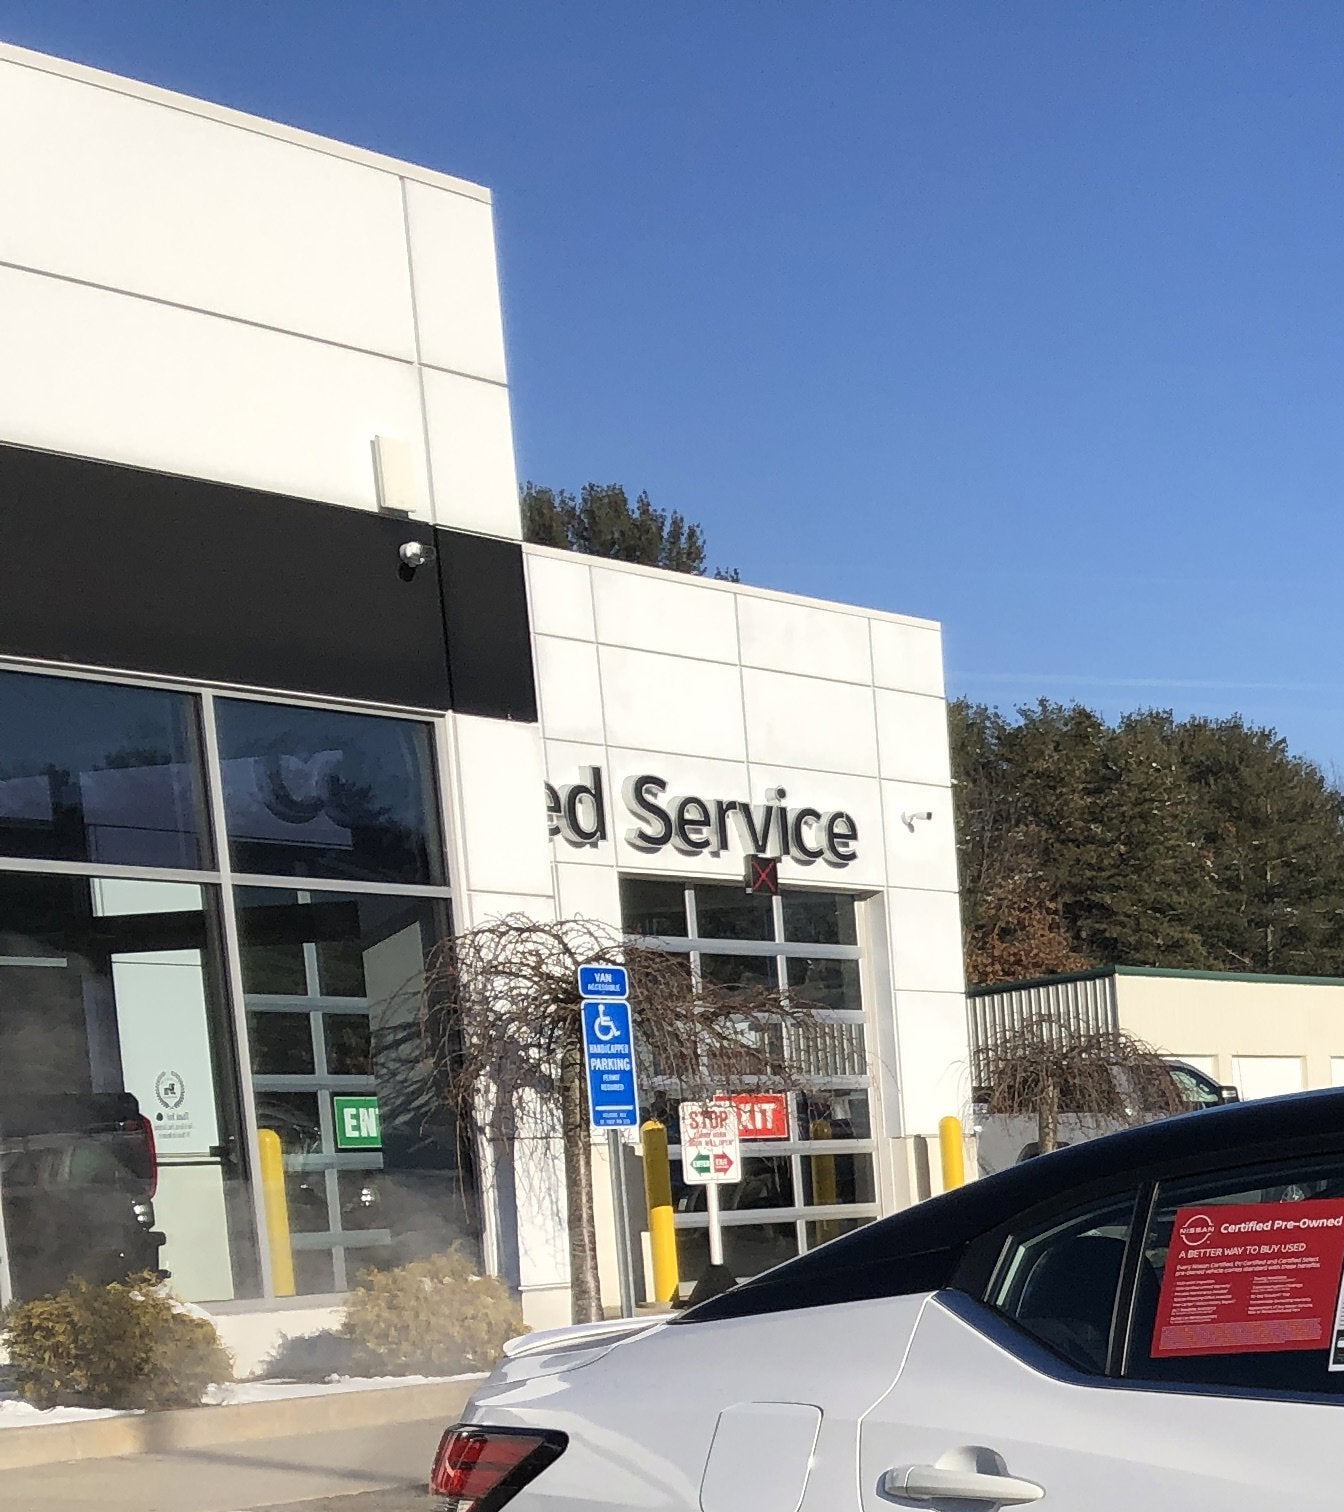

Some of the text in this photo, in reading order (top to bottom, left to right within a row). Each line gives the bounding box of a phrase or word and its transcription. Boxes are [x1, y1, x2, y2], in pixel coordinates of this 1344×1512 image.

[624, 774, 858, 865] Service
[593, 972, 613, 983] VAN
[590, 1057, 631, 1071] PARKING
[343, 1107, 381, 1138] EN
[689, 1109, 728, 1130] STOP
[738, 1102, 777, 1130] XIT
[1179, 1226, 1215, 1236] NISSAN
[1220, 1216, 1344, 1234] Certified Pre-Owned
[1178, 1243, 1307, 1259] A BETTER WAY TO BUY USED
